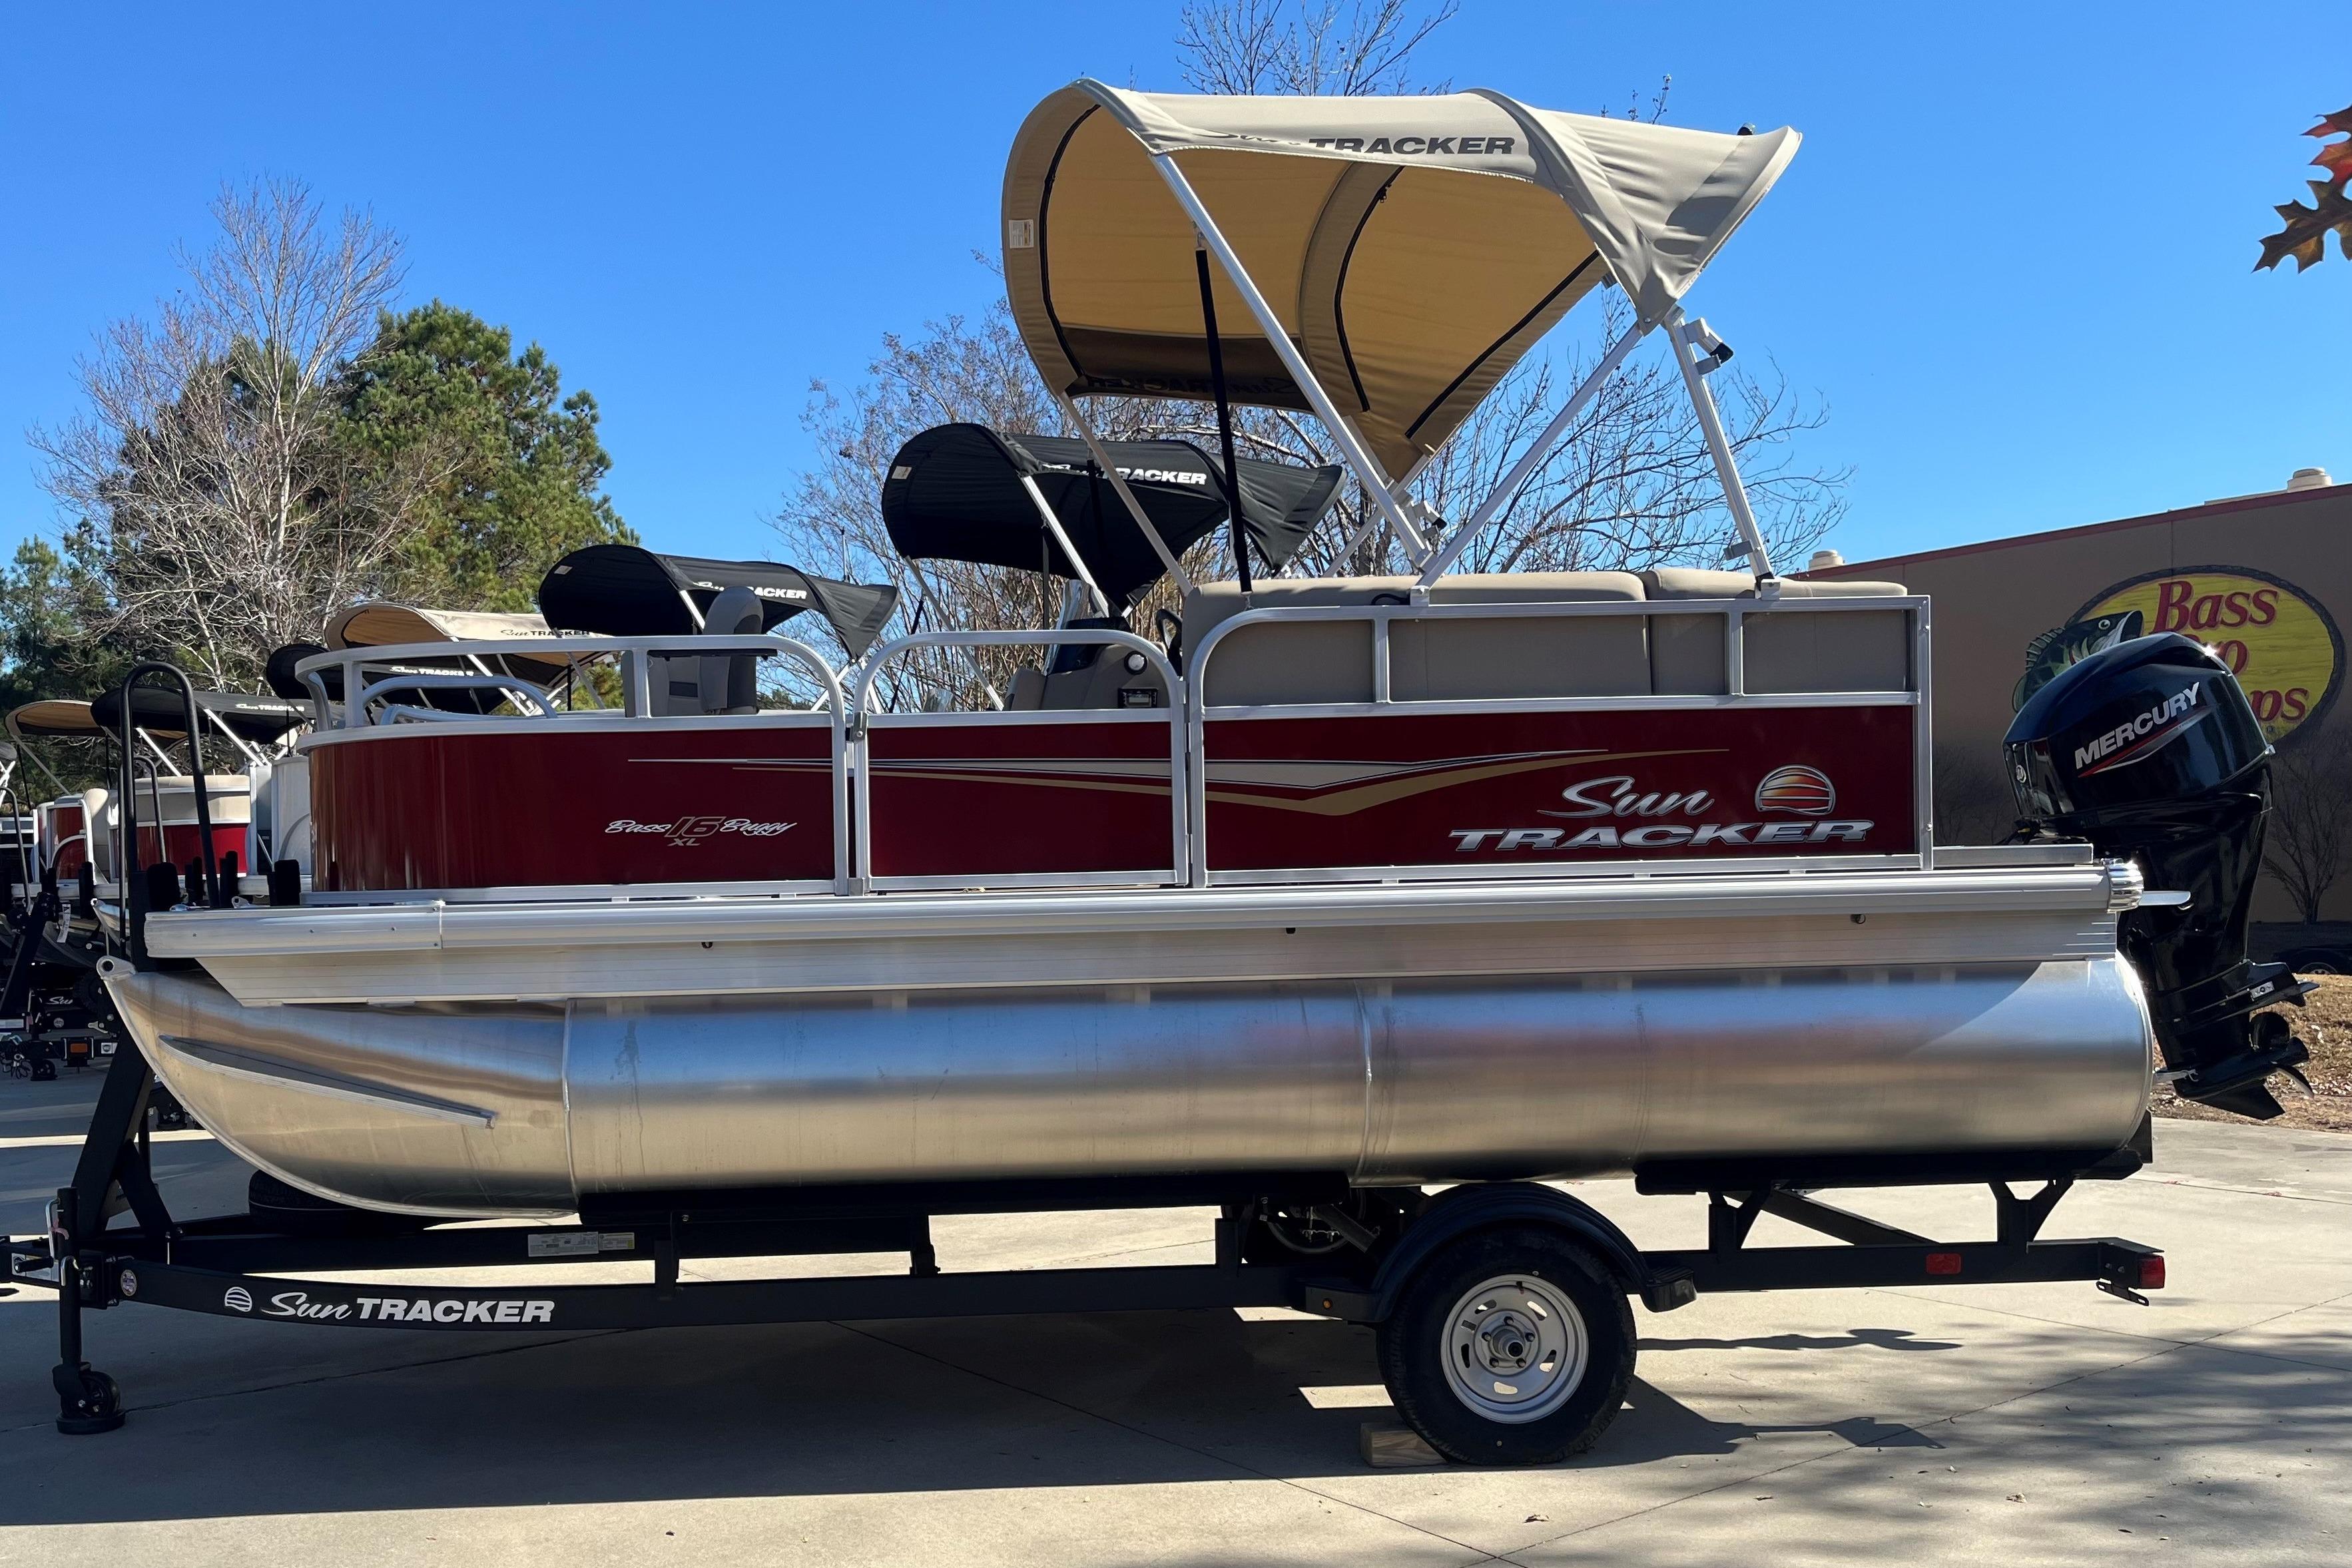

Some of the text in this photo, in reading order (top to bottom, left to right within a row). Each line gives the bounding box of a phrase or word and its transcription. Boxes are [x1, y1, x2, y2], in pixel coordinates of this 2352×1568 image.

[1309, 136, 1516, 154] TRACKER
[746, 586, 806, 599] ACKER
[2149, 581, 2278, 633] Bass
[2074, 681, 2200, 770] MERCURY
[1536, 775, 1715, 818] Sun
[605, 816, 797, 838] Bass 16 Buggy
[667, 838, 701, 846] XL
[1448, 820, 1874, 852] TRACKER
[261, 1292, 555, 1323] Sun TRACKER
